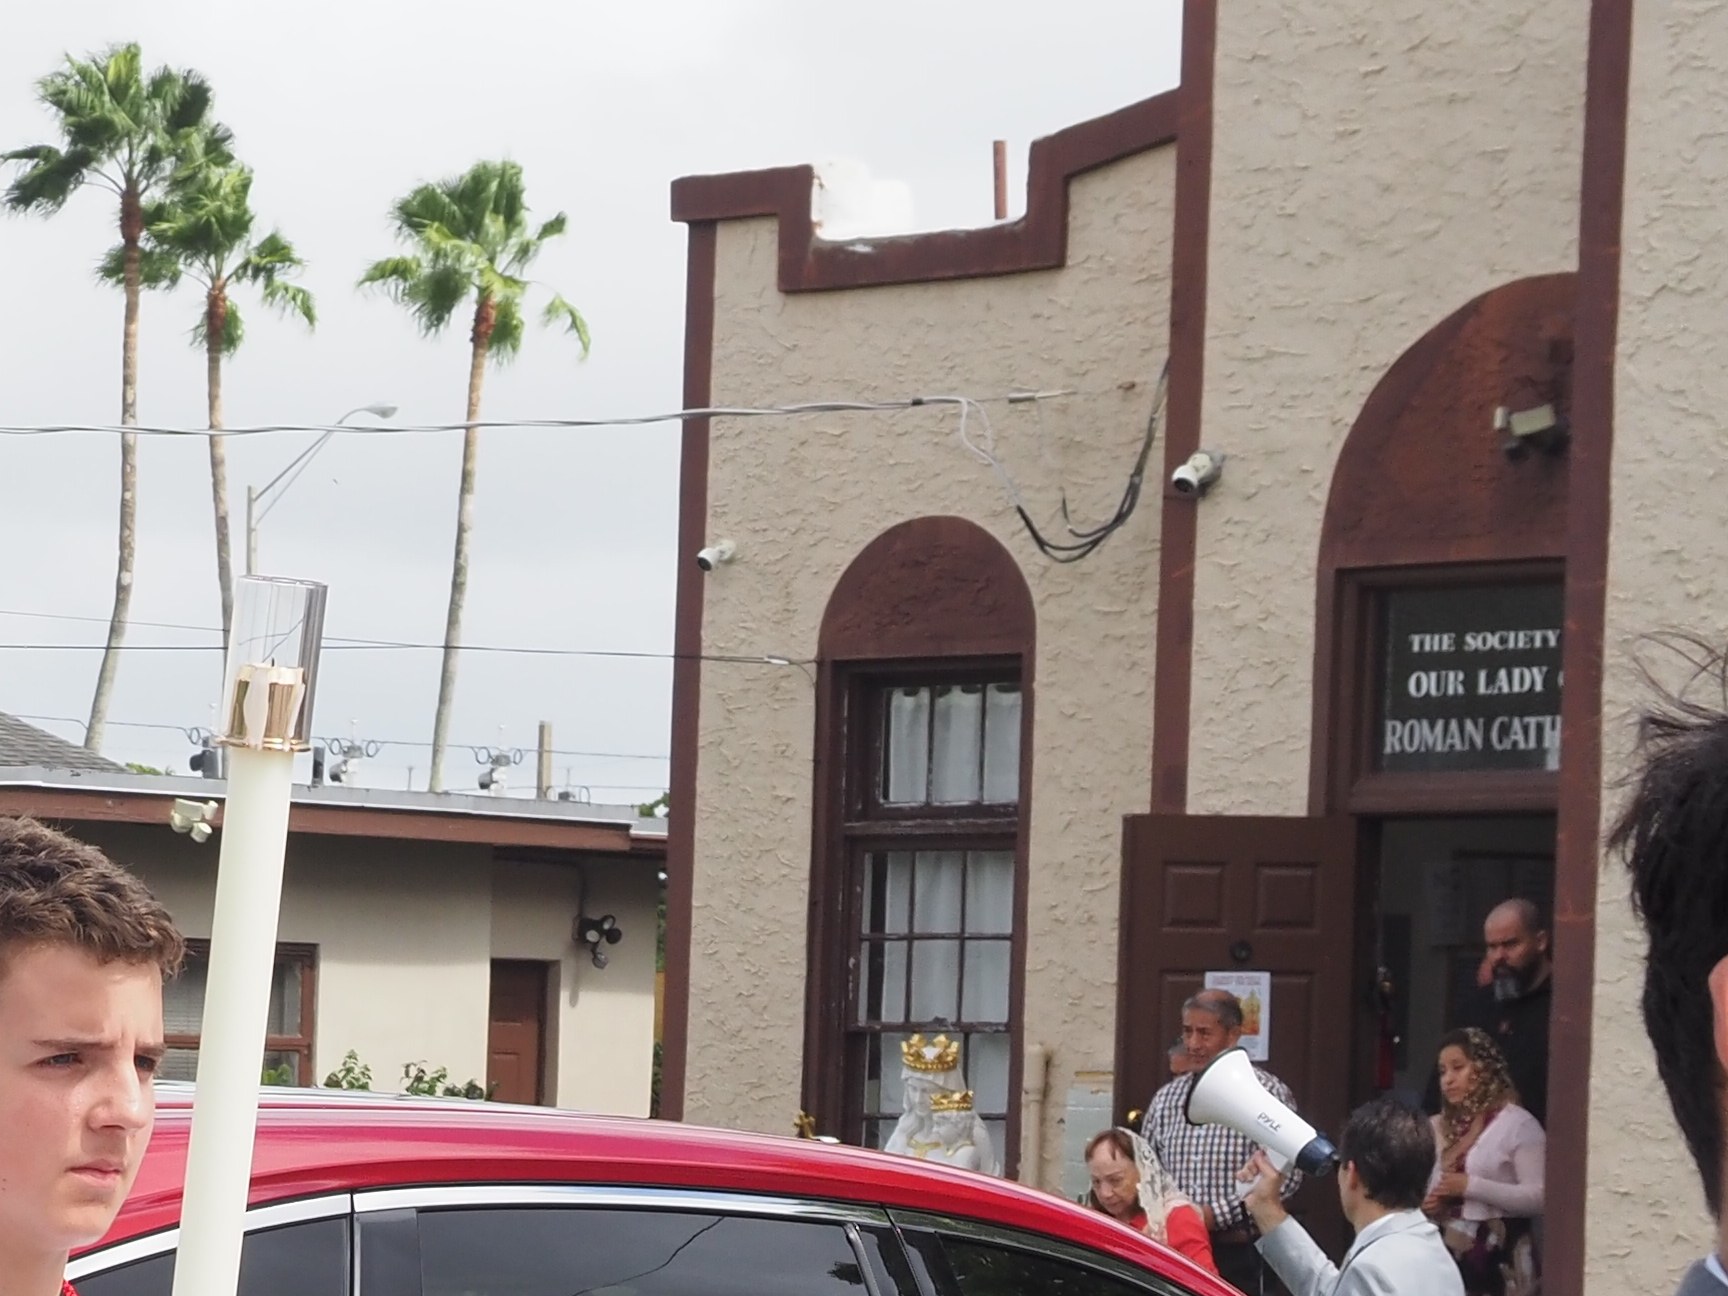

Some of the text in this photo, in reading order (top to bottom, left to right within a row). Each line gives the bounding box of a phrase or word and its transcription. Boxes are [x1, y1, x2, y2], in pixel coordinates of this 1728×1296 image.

[1408, 629, 1560, 653] THE SOCIETY
[1408, 670, 1465, 698] OUR
[1477, 666, 1548, 695] LADY
[1384, 718, 1484, 753] ROMAN
